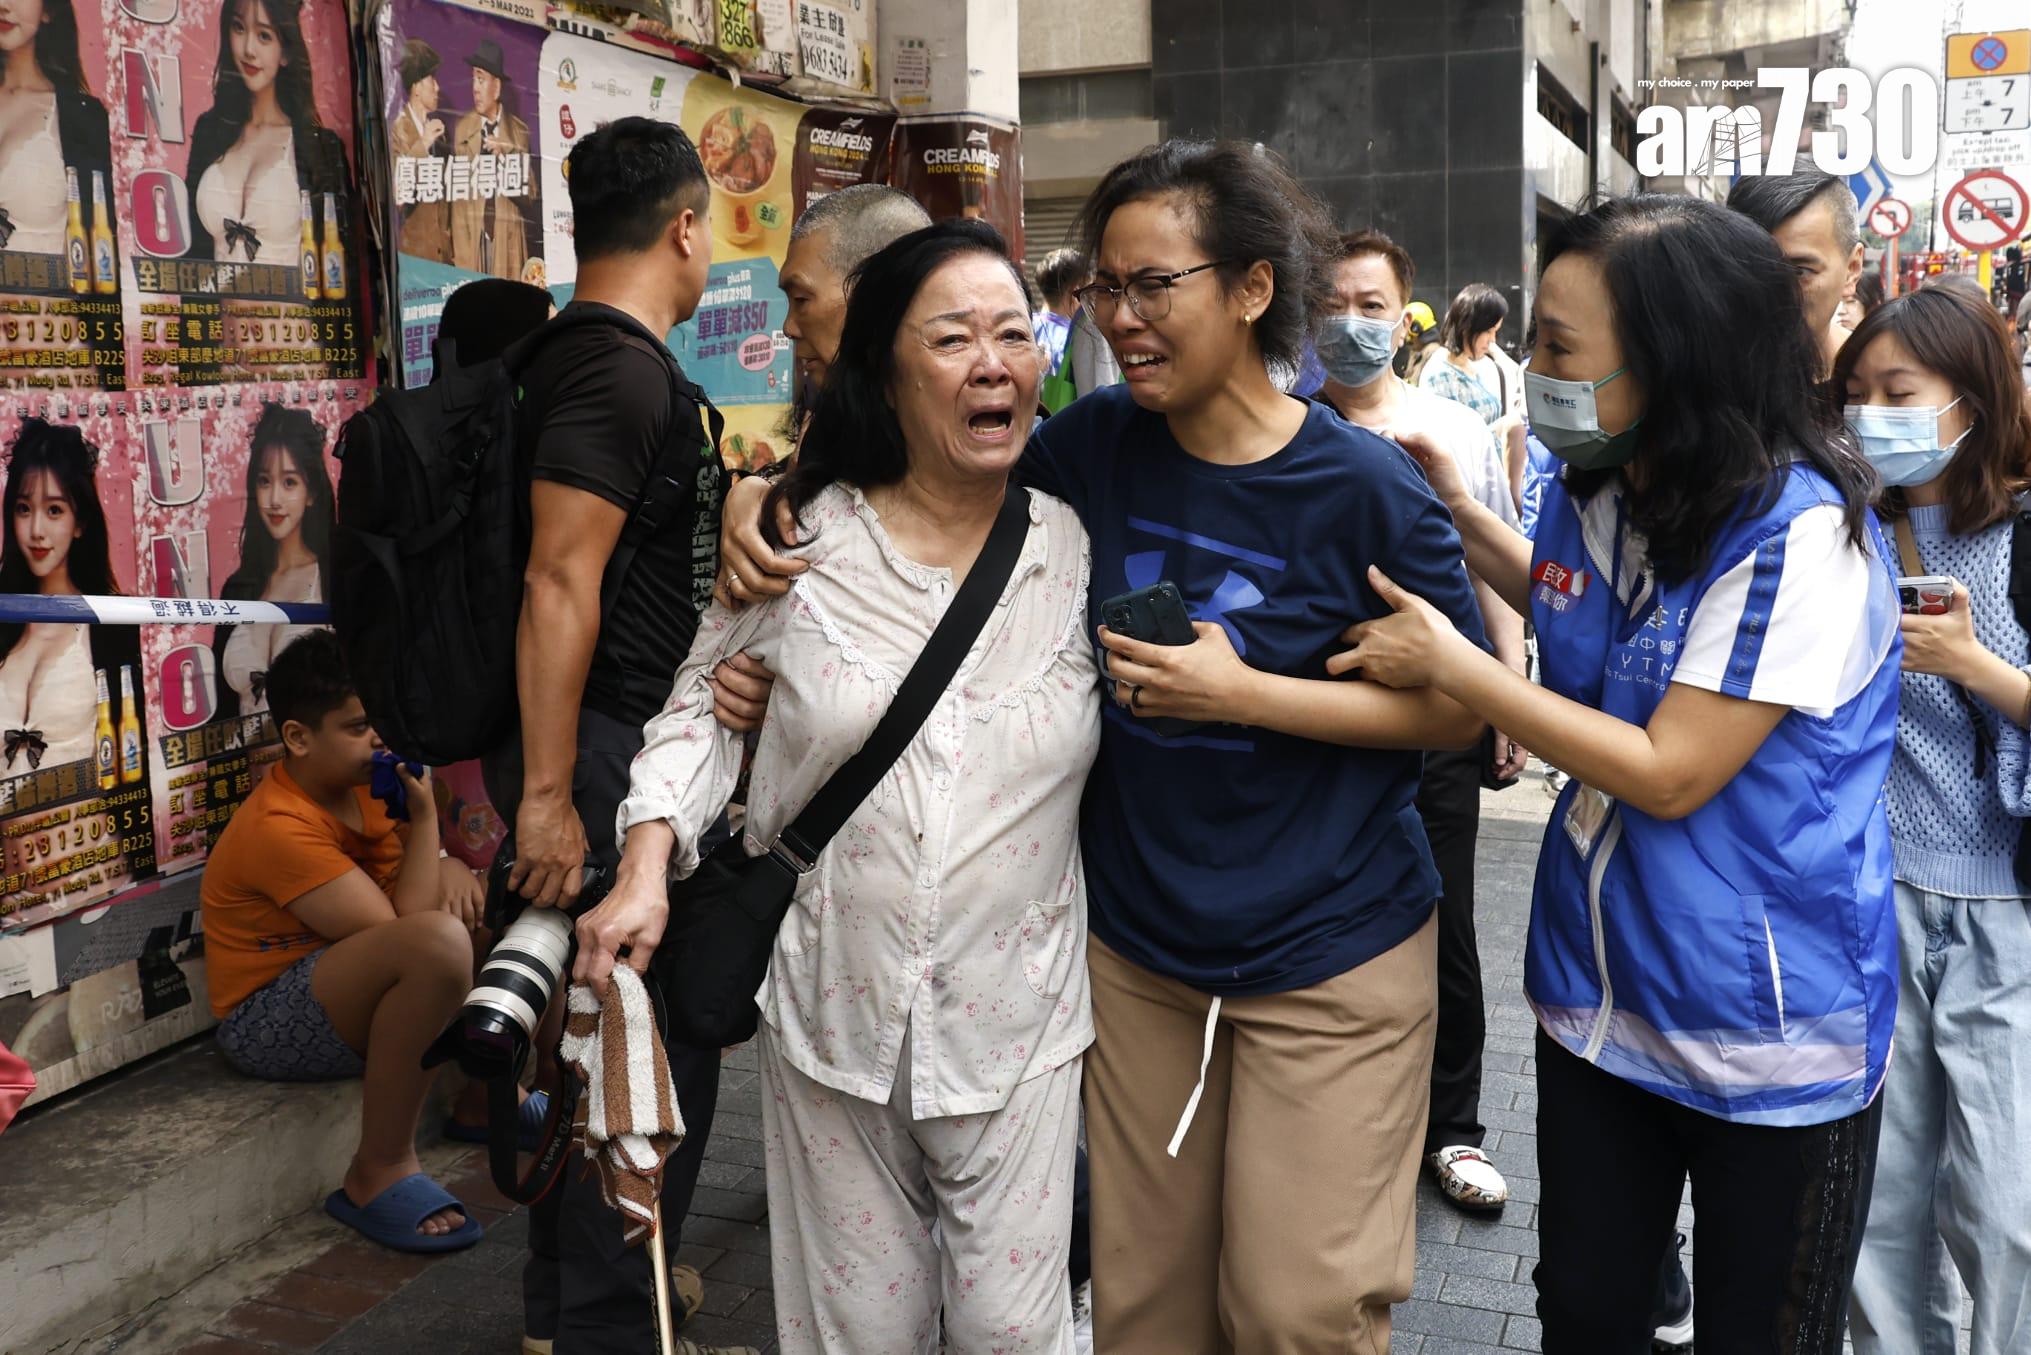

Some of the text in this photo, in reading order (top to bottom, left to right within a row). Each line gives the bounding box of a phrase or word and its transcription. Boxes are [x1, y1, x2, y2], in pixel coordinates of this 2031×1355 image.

[2001, 79, 2015, 97] 7
[2000, 107, 2014, 125] 7
[117, 0, 192, 258] NO
[809, 127, 873, 152] CREAMFIELDS
[923, 147, 1001, 169] CREAMFDS
[927, 163, 961, 174] HONG
[94, 350, 126, 367] B225
[325, 348, 358, 362] B225
[336, 367, 360, 379] East
[149, 599, 241, 618] 不得越過
[122, 831, 153, 855] B225
[134, 856, 154, 869] East
[543, 1135, 561, 1163] Mark
